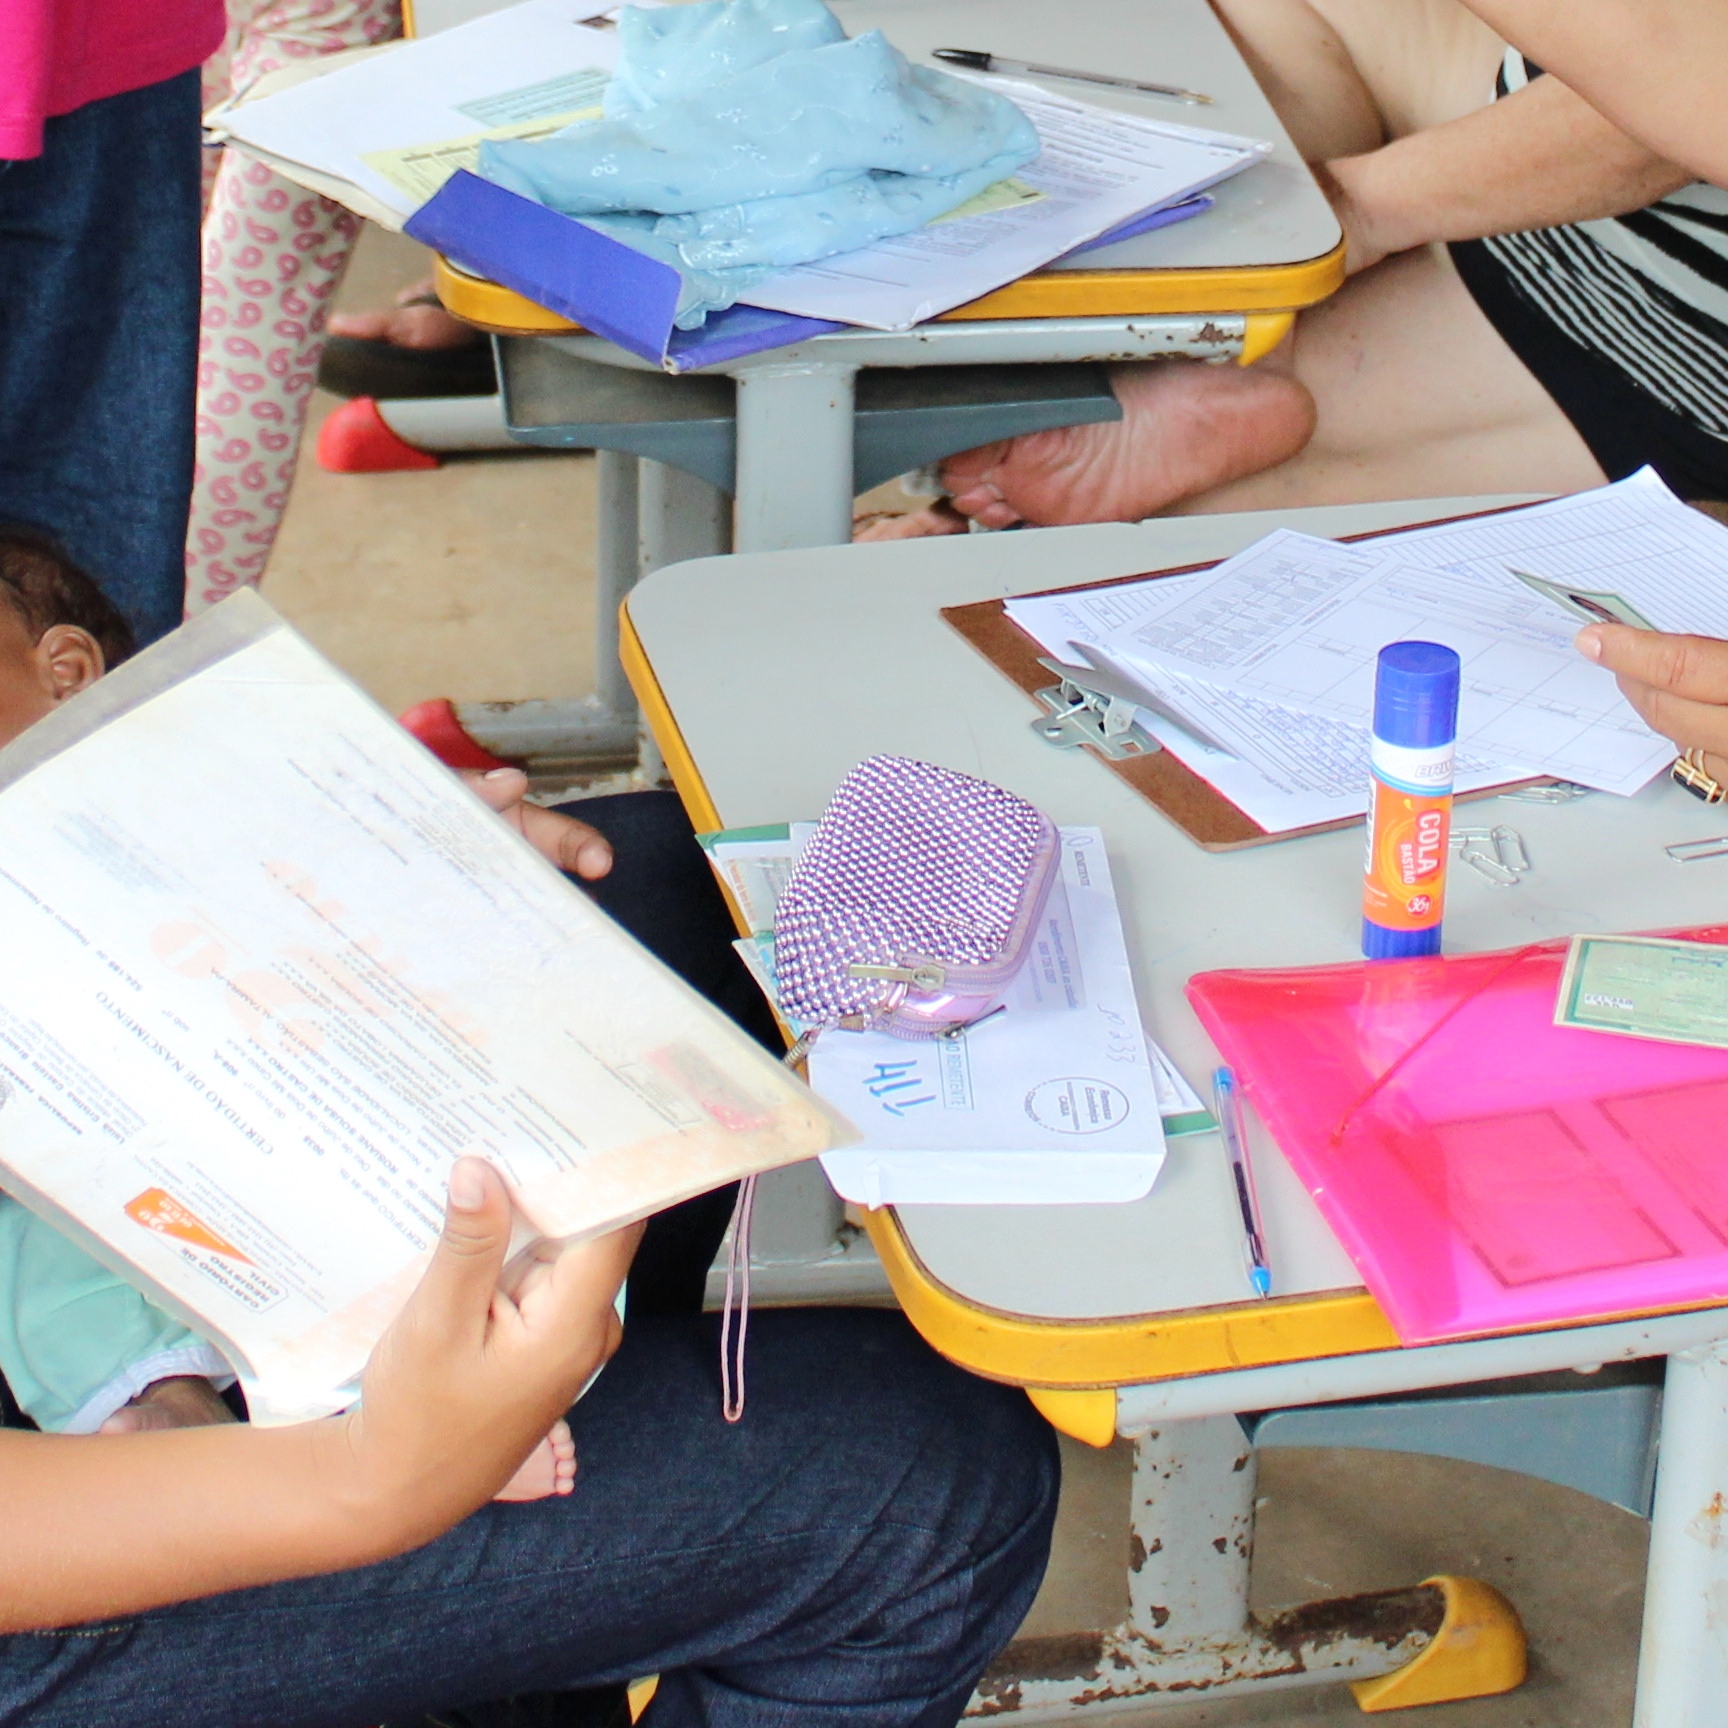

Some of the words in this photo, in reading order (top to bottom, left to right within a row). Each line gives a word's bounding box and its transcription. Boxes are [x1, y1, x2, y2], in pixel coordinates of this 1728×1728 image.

[1417, 813, 1441, 875] COLA
[1400, 844, 1415, 885] BASTÃO
[52, 911, 92, 948] Registro
[93, 988, 186, 1074] NASCIMENTO
[171, 1014, 191, 1034] sob
[29, 1058, 65, 1092] Castelo
[181, 1068, 206, 1093] DE
[245, 1055, 273, 1081] Cinco
[266, 1054, 309, 1094] CASTRO
[327, 1063, 352, 1087] SÃO
[944, 1053, 968, 1107] REMETENTE
[64, 1089, 101, 1124] Cristina
[252, 1088, 275, 1110] livro
[284, 1090, 307, 1112] Dois
[306, 1090, 324, 1107] DE
[348, 1078, 413, 1138] LOCALIDADE
[386, 1081, 416, 1109] SILVA
[1057, 1094, 1070, 1117] CAIXA
[35, 1092, 84, 1138] REPÚBLICA
[201, 1088, 276, 1157] CERTIDÃO
[271, 1105, 287, 1121] do
[321, 1102, 358, 1137] SOUSA
[414, 1104, 465, 1150] BENEDITO
[315, 1119, 342, 1144] Julho
[350, 1152, 371, 1172] Dez
[354, 1132, 400, 1175] ROSIANE
[359, 1185, 381, 1207] que
[375, 1202, 429, 1252] CERTIFICO
[179, 1245, 198, 1263] DE
[196, 1255, 260, 1315] CARTÓRIO
[208, 1250, 270, 1308] REGISTRO
[247, 1267, 281, 1299] CIVIL
